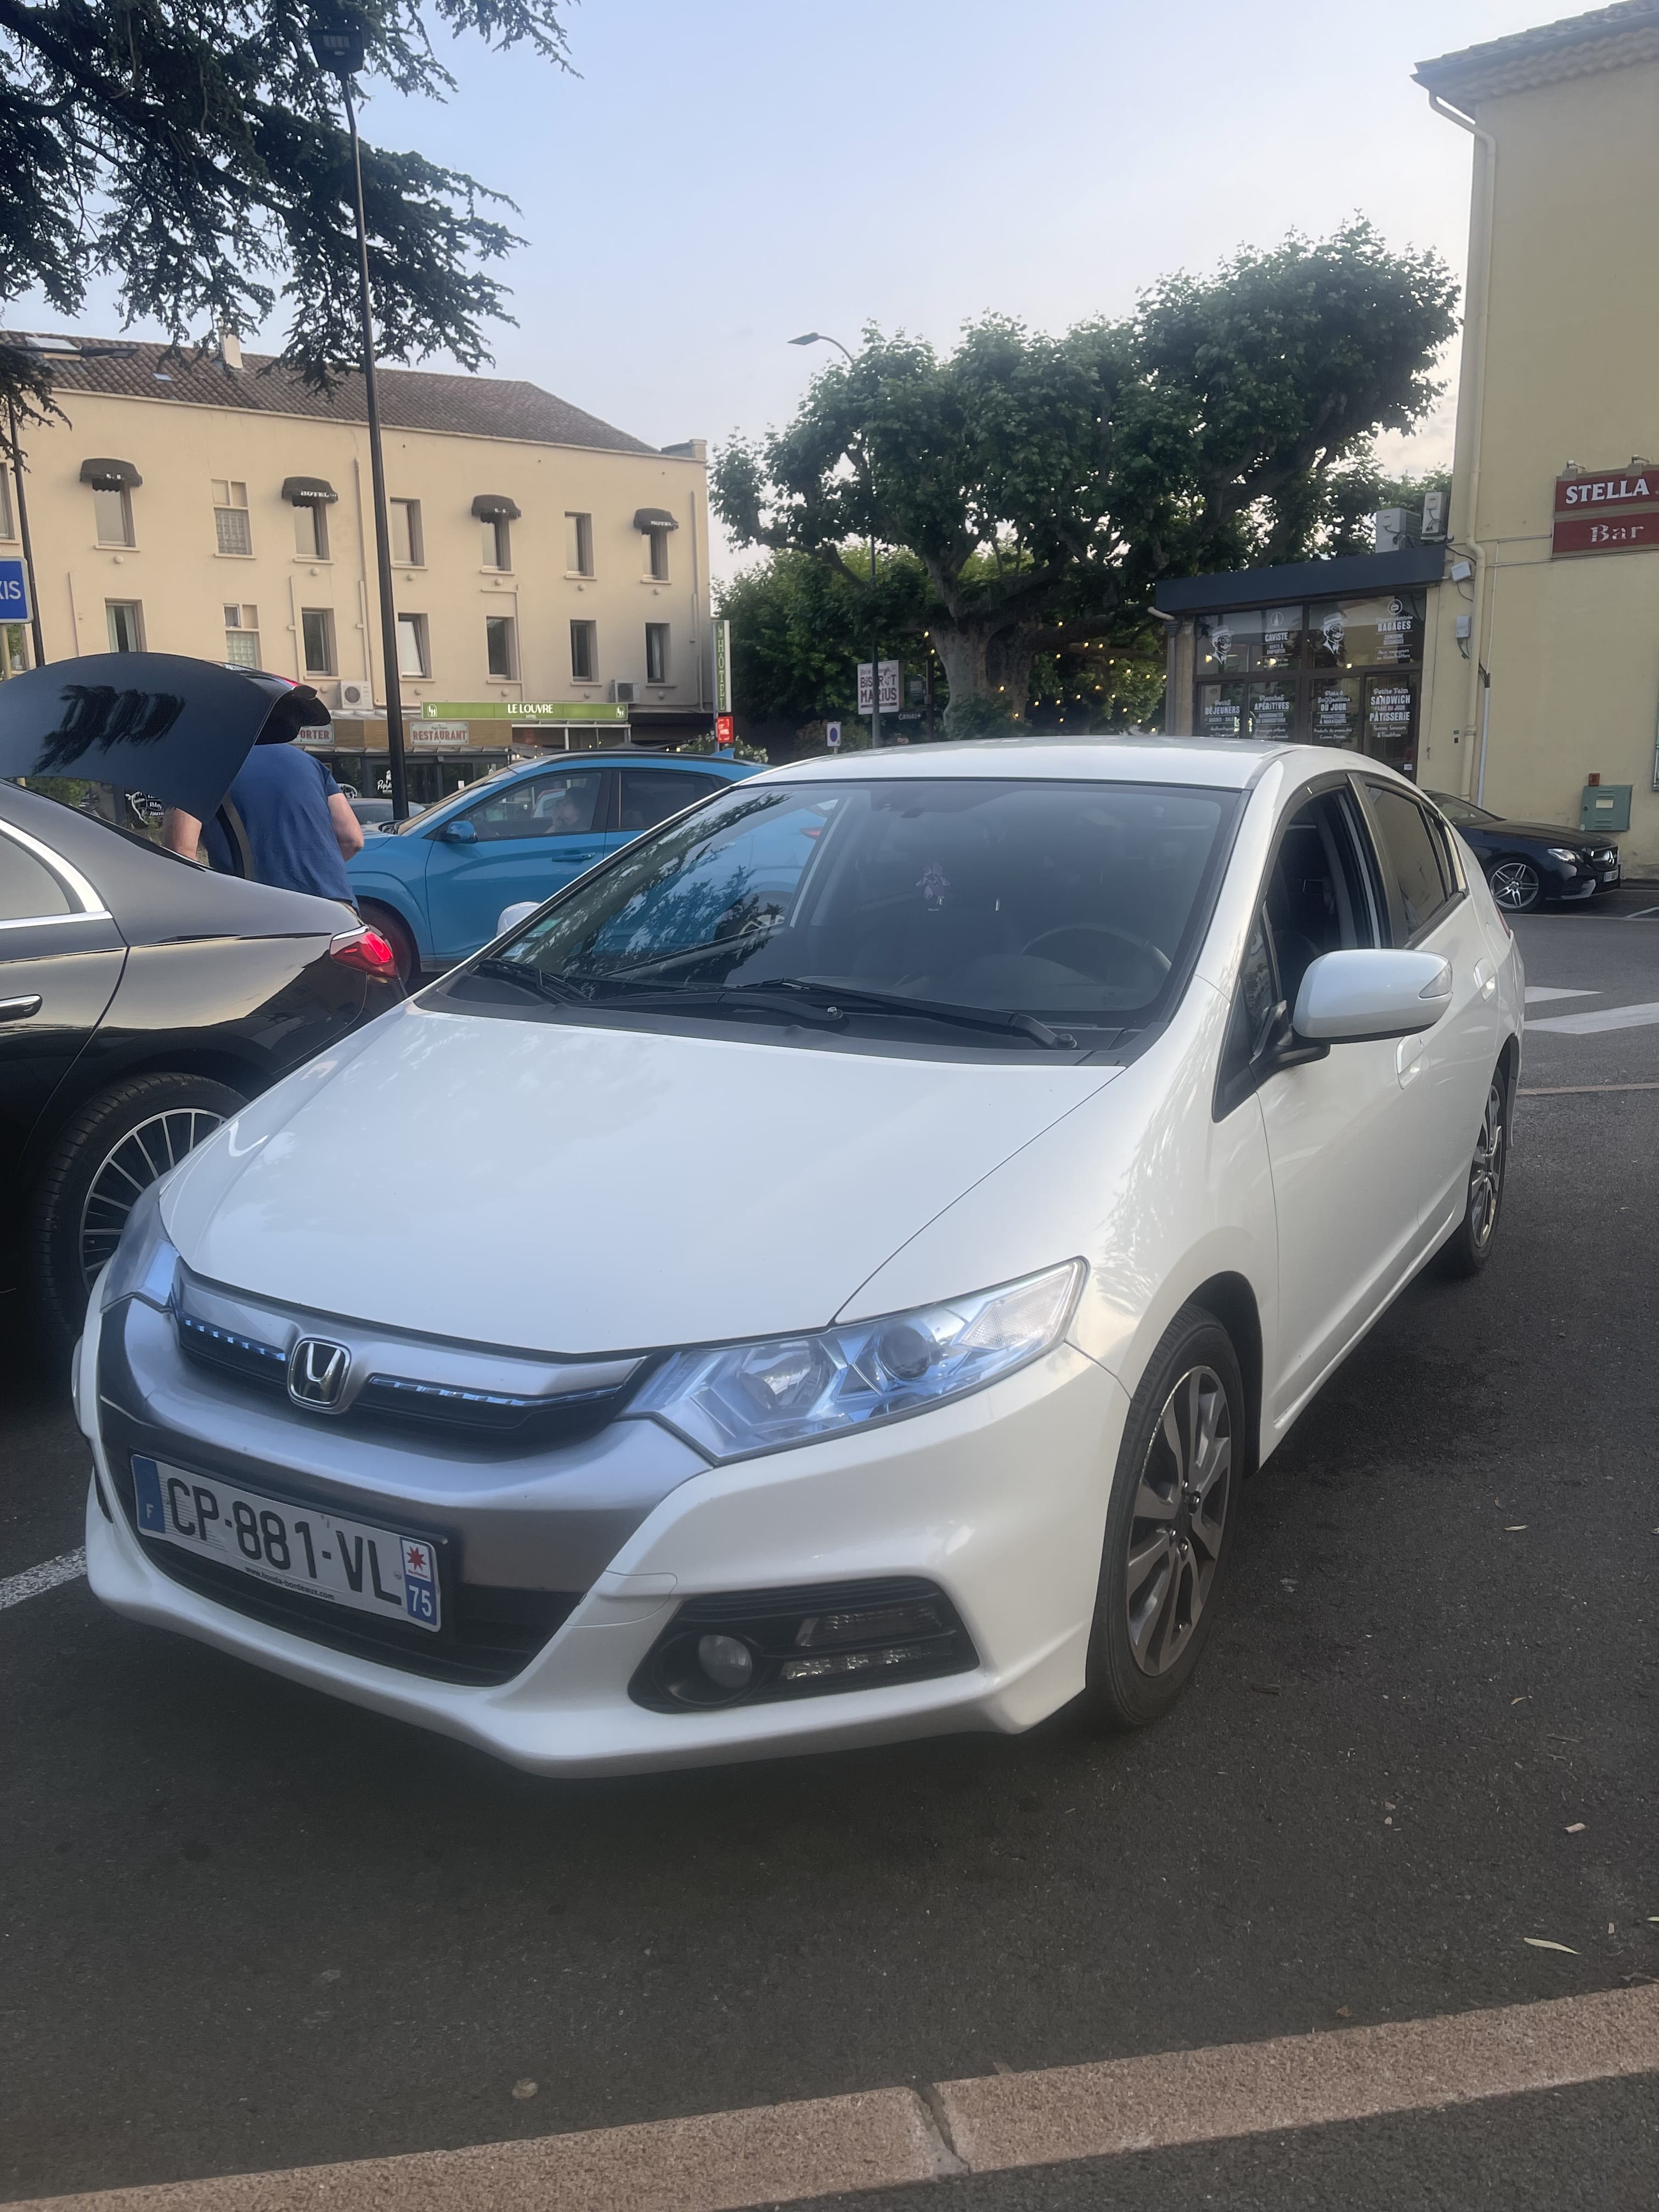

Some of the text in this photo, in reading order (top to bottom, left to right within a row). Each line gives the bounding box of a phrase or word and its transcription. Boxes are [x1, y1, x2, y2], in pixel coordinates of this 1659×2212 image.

[1565, 478, 1651, 505] STELLA
[1590, 524, 1645, 543] Bar
[0, 580, 21, 600] IS
[1378, 620, 1411, 631] BAGAGES
[507, 703, 554, 714] LE LOUVRE
[1205, 705, 1240, 715] DÉJEUNERS
[1321, 703, 1347, 712] DU JOUR
[298, 729, 330, 739] ORTER
[413, 730, 466, 740] RESTAURANT
[145, 1503, 155, 1520] F
[167, 1477, 402, 1606] CP-881-VL
[245, 1566, 335, 1600] www.honda-bordeaux.com
[408, 1584, 432, 1617] 75
